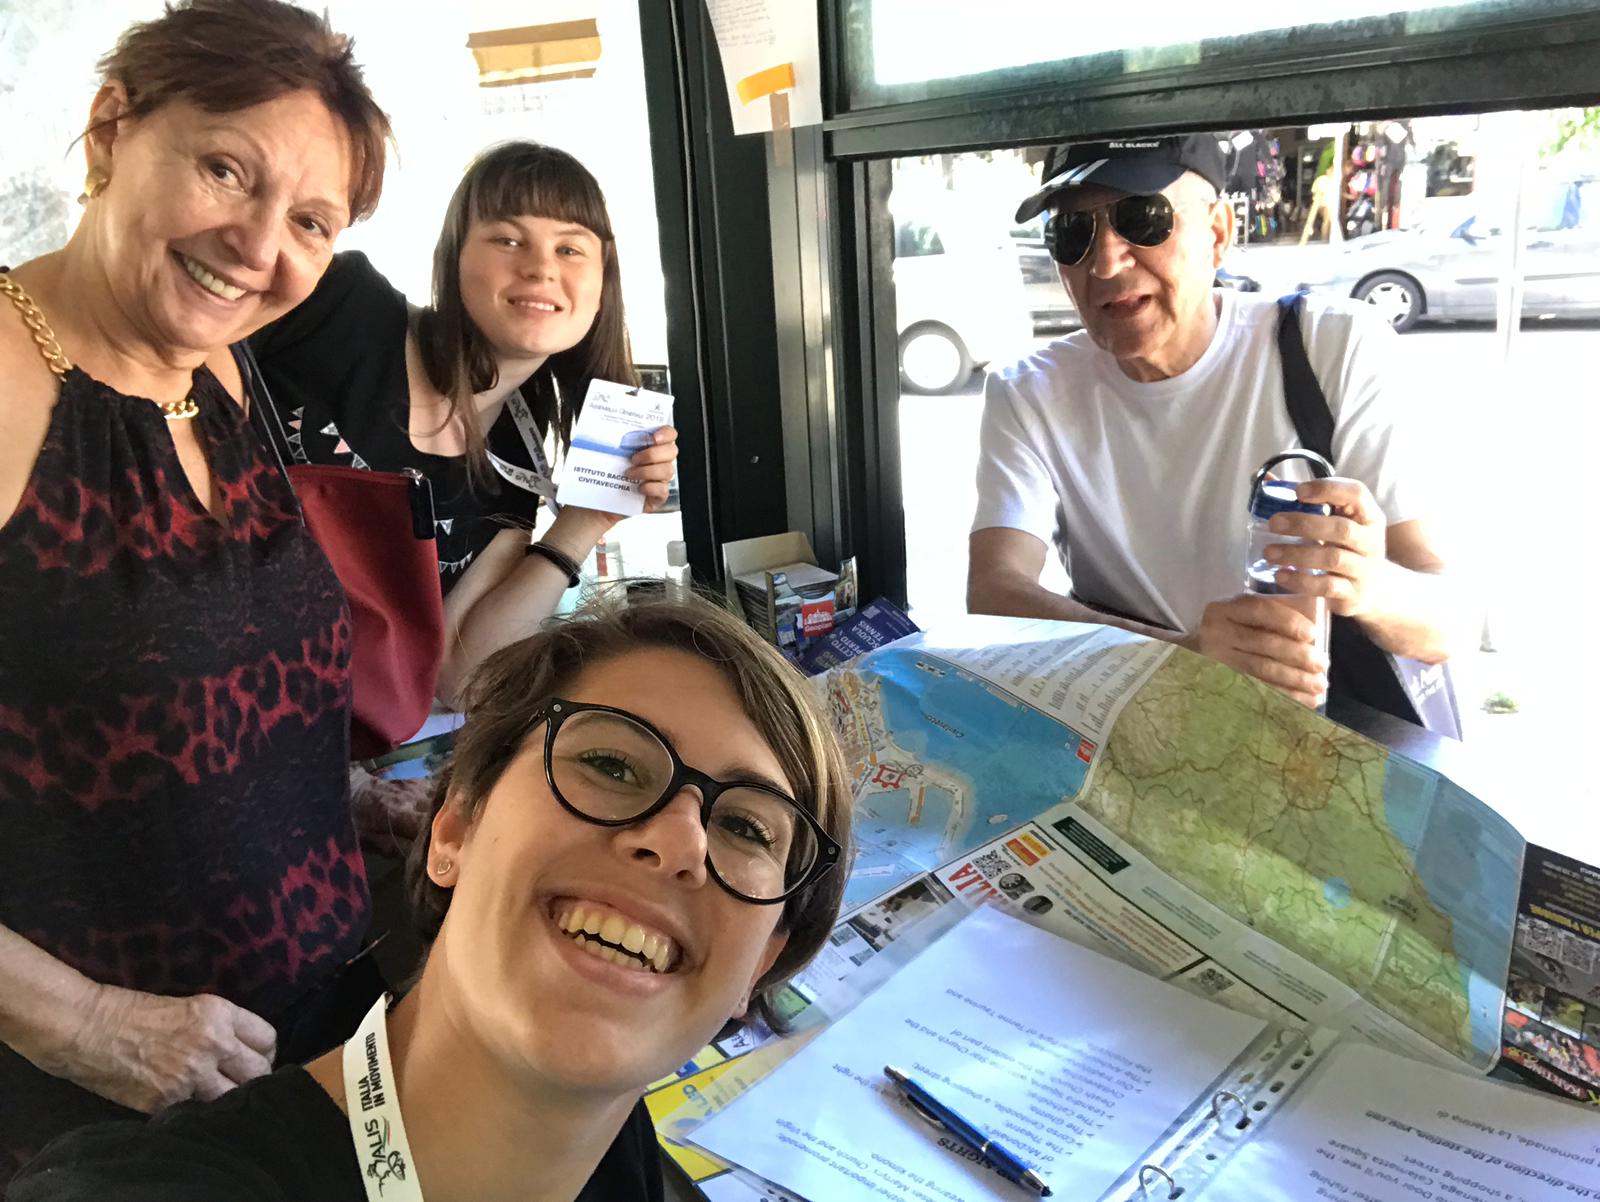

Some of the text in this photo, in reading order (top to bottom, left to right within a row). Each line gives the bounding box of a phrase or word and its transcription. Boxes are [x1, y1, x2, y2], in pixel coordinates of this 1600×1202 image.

[573, 465, 605, 477] ISTITUTO
[578, 475, 631, 492] CIVITAVECCHIA
[851, 623, 880, 651] SCUOLA
[857, 617, 884, 643] TENNIS
[918, 1025, 938, 1038] and
[962, 1032, 983, 1048] part
[935, 1033, 969, 1055] Church
[365, 1031, 385, 1108] IN MOVIMENTO
[830, 1060, 855, 1079] right
[852, 1074, 869, 1087] the
[358, 1075, 373, 1112] ITALIA
[774, 1114, 802, 1135] Virgin
[1075, 1112, 1094, 1127] The
[1364, 1109, 1387, 1123] can
[1388, 1118, 1412, 1132] you
[1450, 1113, 1495, 1134] Marina
[800, 1129, 817, 1143] the
[1045, 1126, 1075, 1145] Corso
[1064, 1121, 1084, 1136] The
[1497, 1129, 1512, 1140] La
[365, 1118, 386, 1161] ALIS
[816, 1137, 835, 1152] and
[1044, 1140, 1063, 1154] The
[1314, 1146, 1335, 1160] the
[1326, 1137, 1370, 1161] Square
[1462, 1147, 1485, 1161] the
[1514, 1132, 1594, 1168] promenade,
[835, 1148, 869, 1171] Church
[1040, 1152, 1054, 1165] of
[1484, 1154, 1502, 1167] of
[827, 1158, 876, 1190] important
[906, 1170, 924, 1185] the
[1370, 1155, 1434, 1186] Calamatta
[1502, 1161, 1564, 1189] direction
[1306, 1168, 1350, 1194] fishing
[1440, 1168, 1502, 1197] shopping
[1400, 1181, 1432, 1200] Door
[1565, 1183, 1589, 1198] the
